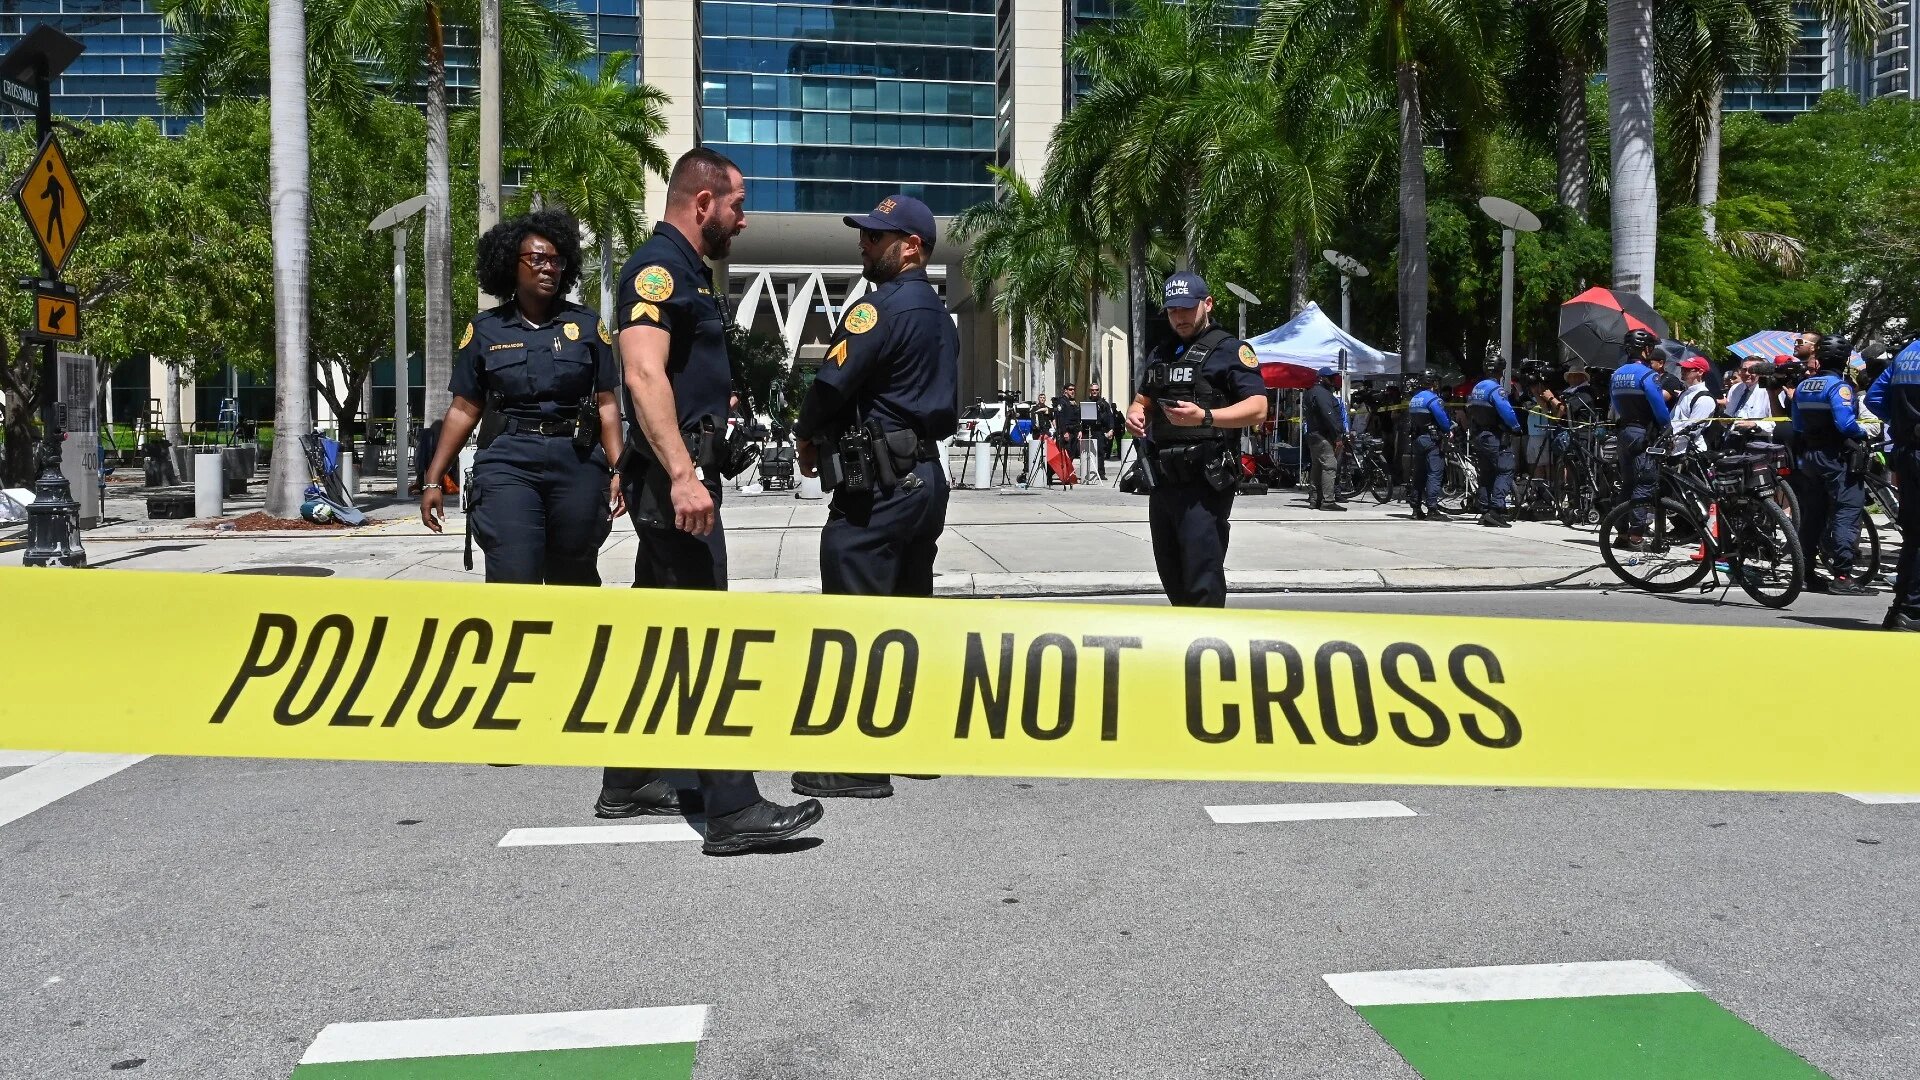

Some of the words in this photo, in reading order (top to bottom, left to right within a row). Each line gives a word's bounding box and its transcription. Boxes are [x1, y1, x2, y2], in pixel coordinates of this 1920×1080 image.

[4, 79, 39, 107] CROSSWALK
[81, 452, 98, 471] 400
[209, 612, 553, 730] POLICE
[562, 624, 775, 737] LINE
[791, 628, 919, 738] DO
[955, 632, 1142, 742] NOT
[1185, 637, 1522, 748] CROSS
